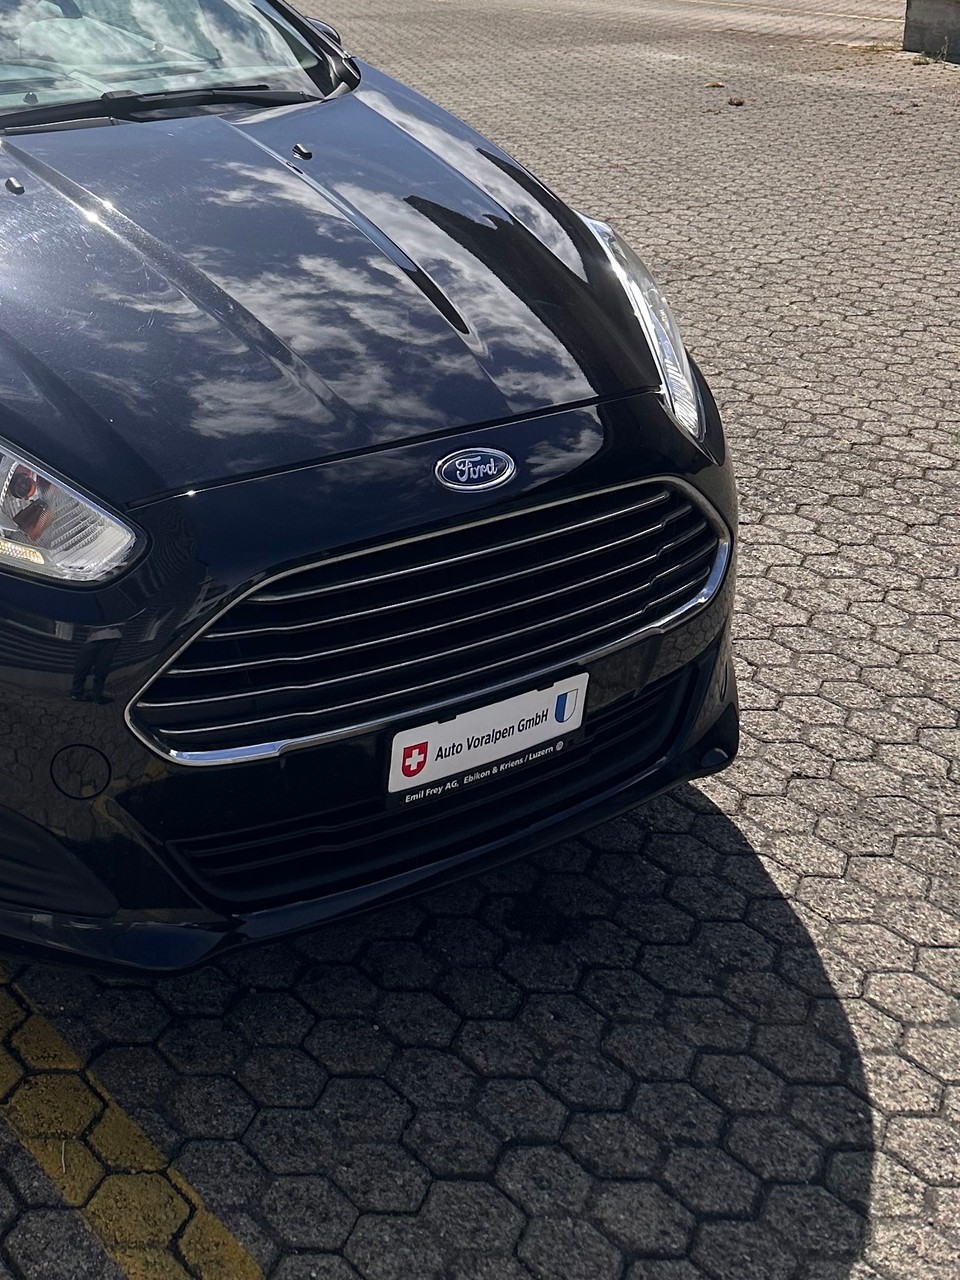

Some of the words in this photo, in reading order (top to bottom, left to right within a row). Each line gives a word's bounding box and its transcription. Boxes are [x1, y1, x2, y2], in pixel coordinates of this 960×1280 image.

[455, 455, 498, 482] Ford
[434, 741, 463, 761] Auto
[466, 723, 515, 751] Voralpen
[517, 708, 549, 733] GmbH
[405, 790, 424, 803] Emil
[425, 785, 444, 797] Frey
[445, 780, 459, 790] AG,
[463, 770, 491, 784] Ebikon
[491, 766, 498, 774] &
[499, 757, 524, 771] Kriens
[528, 746, 554, 760] Luzern
